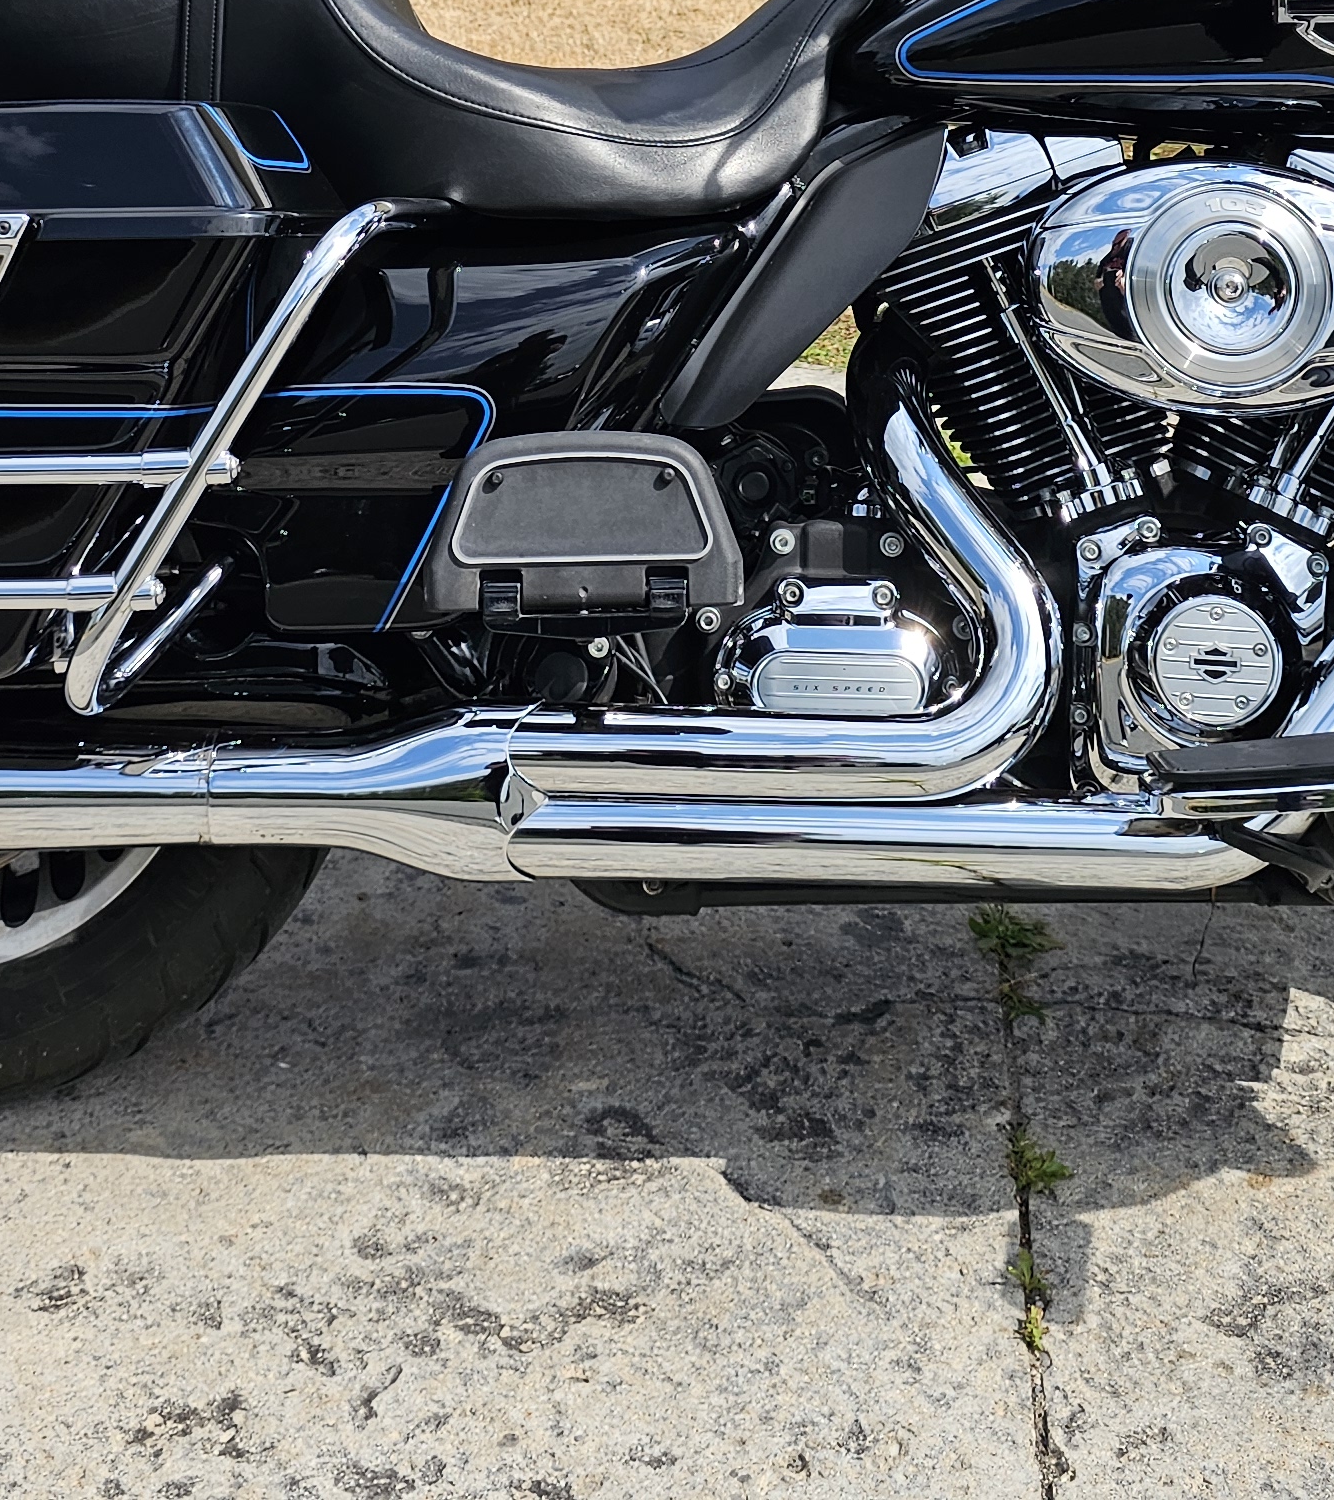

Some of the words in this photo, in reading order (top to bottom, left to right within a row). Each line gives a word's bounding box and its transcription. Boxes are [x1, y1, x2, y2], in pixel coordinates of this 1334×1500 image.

[1204, 197, 1267, 217] 103
[792, 684, 820, 692] SIX
[831, 685, 886, 693] SPEED
